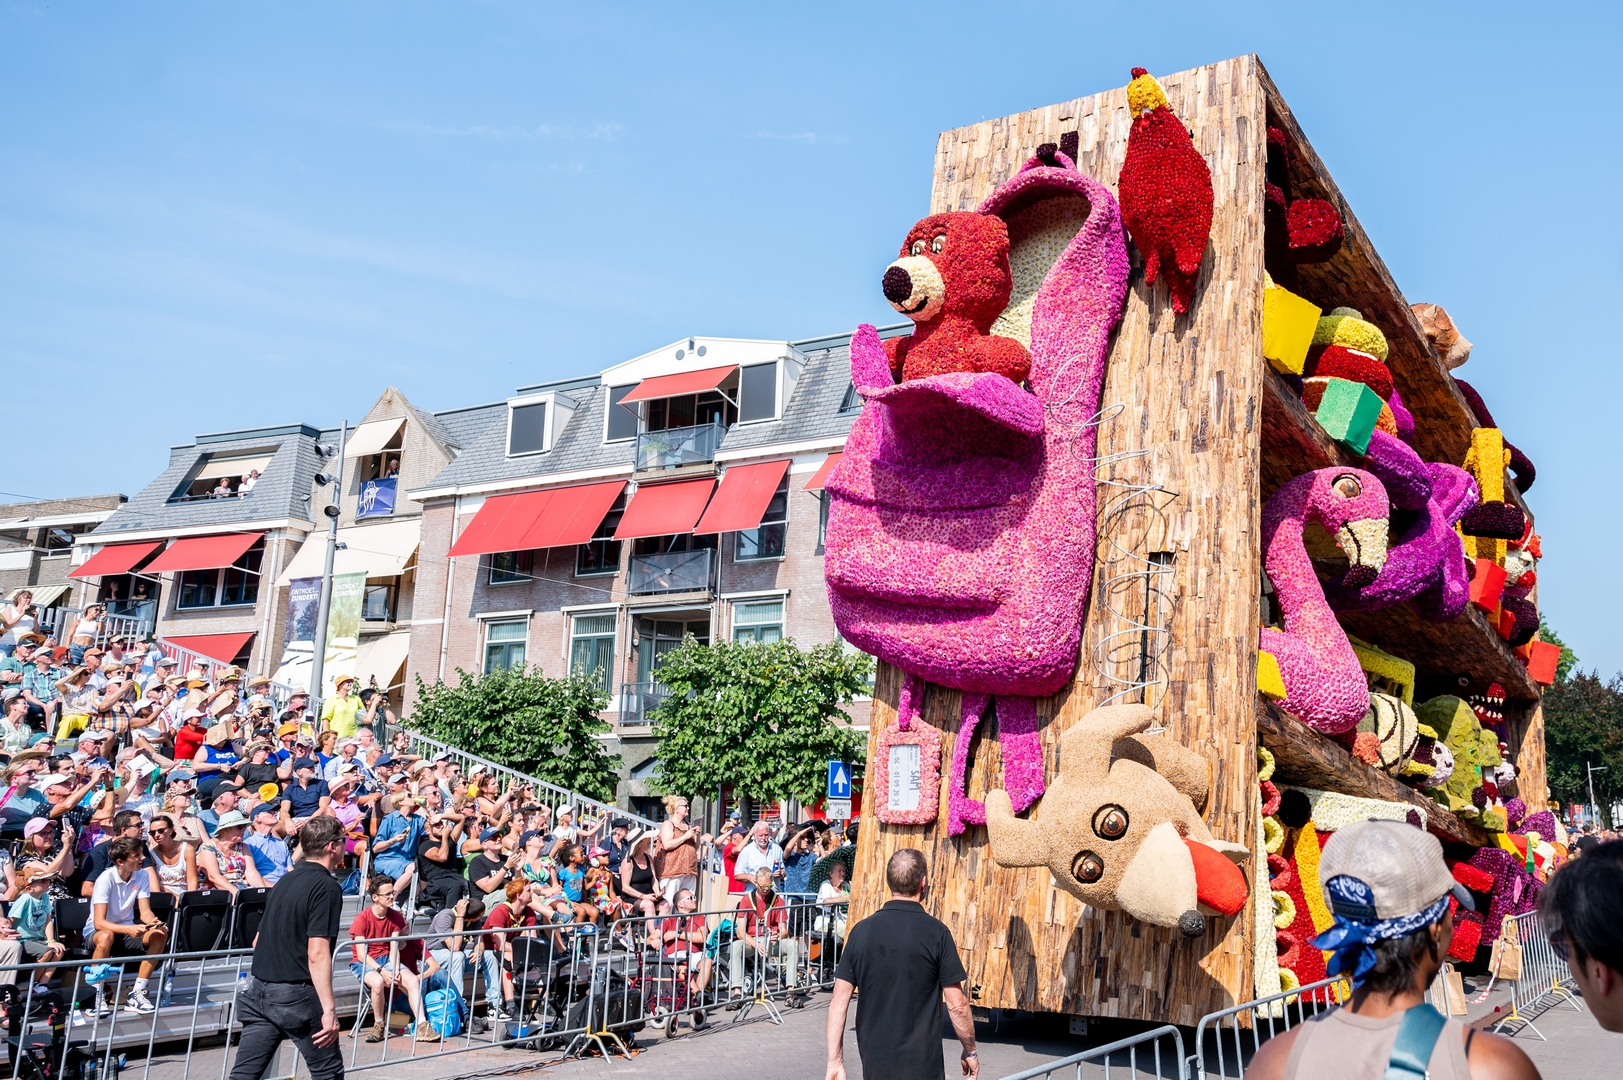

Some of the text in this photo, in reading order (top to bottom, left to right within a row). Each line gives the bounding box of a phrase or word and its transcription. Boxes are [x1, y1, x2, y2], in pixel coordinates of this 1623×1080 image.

[334, 588, 362, 597] ZUNDERT!
[291, 594, 318, 602] ZUNDERT!
[909, 770, 920, 790] SAM
